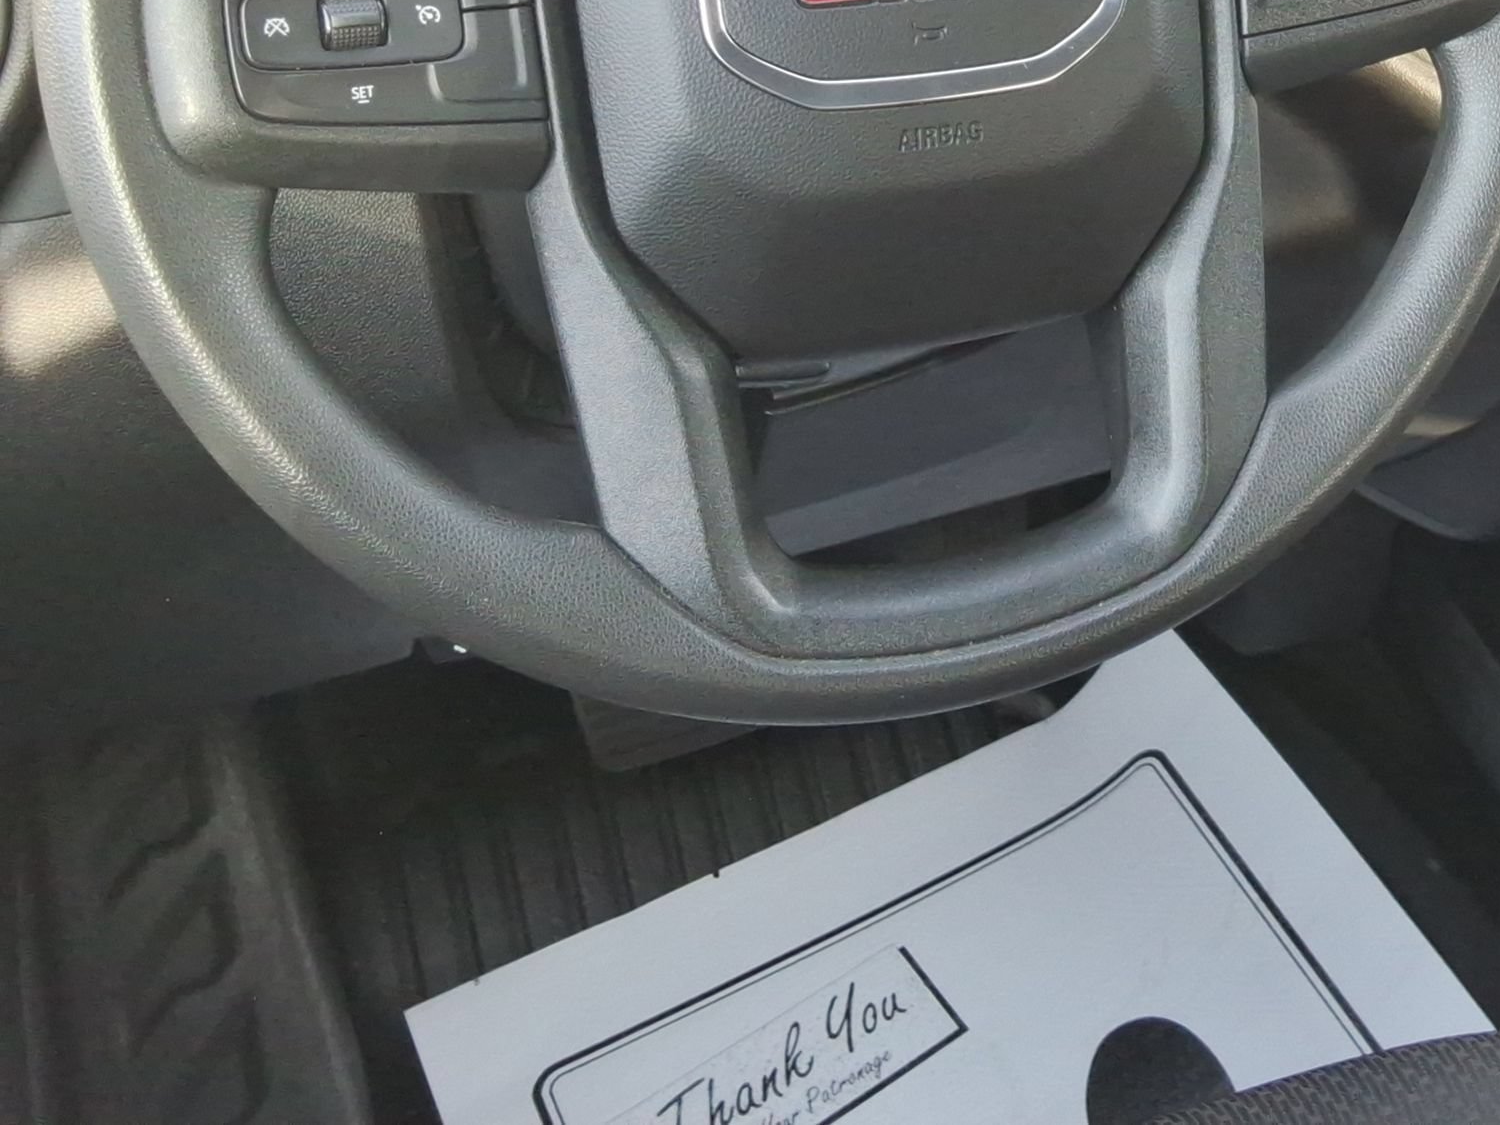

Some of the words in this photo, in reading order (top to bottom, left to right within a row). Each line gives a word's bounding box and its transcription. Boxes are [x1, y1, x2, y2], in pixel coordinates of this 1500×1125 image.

[351, 84, 374, 100] SET
[898, 120, 984, 152] AIRBAG
[657, 1021, 815, 1125] Thank
[825, 981, 908, 1054] You
[804, 1049, 893, 1115] Patronage
